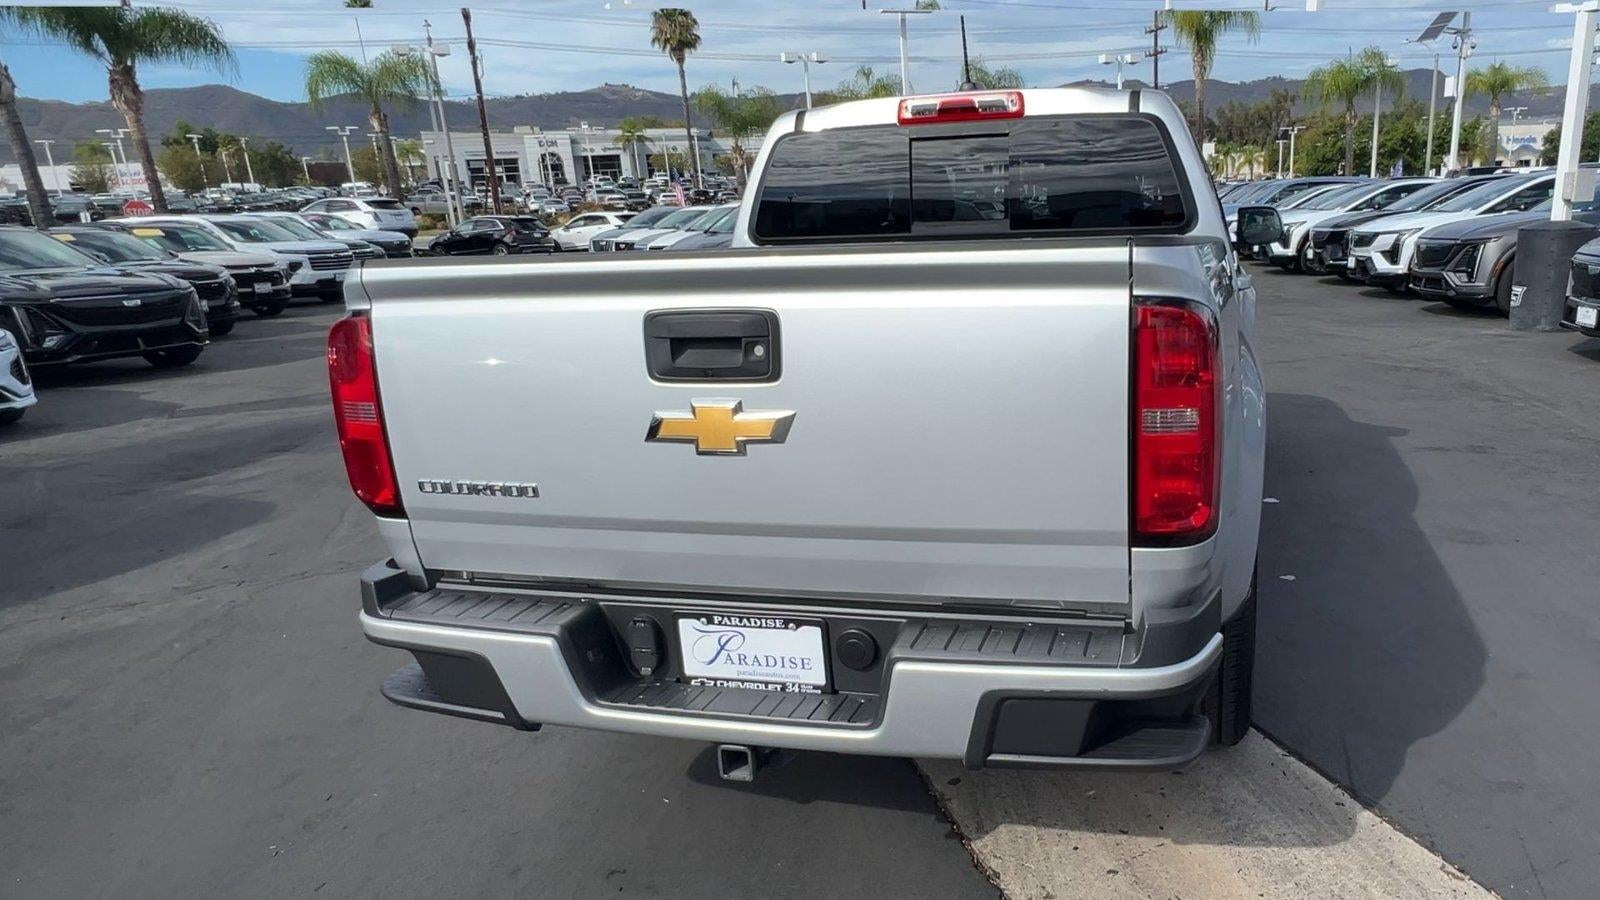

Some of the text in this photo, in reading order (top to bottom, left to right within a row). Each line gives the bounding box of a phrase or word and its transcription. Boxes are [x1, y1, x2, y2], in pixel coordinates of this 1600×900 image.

[126, 208, 152, 217] STOP
[418, 479, 540, 498] COLORADO
[713, 615, 785, 629] PARADISE
[716, 680, 783, 692] CHEVROLET
[785, 682, 800, 693] 34
